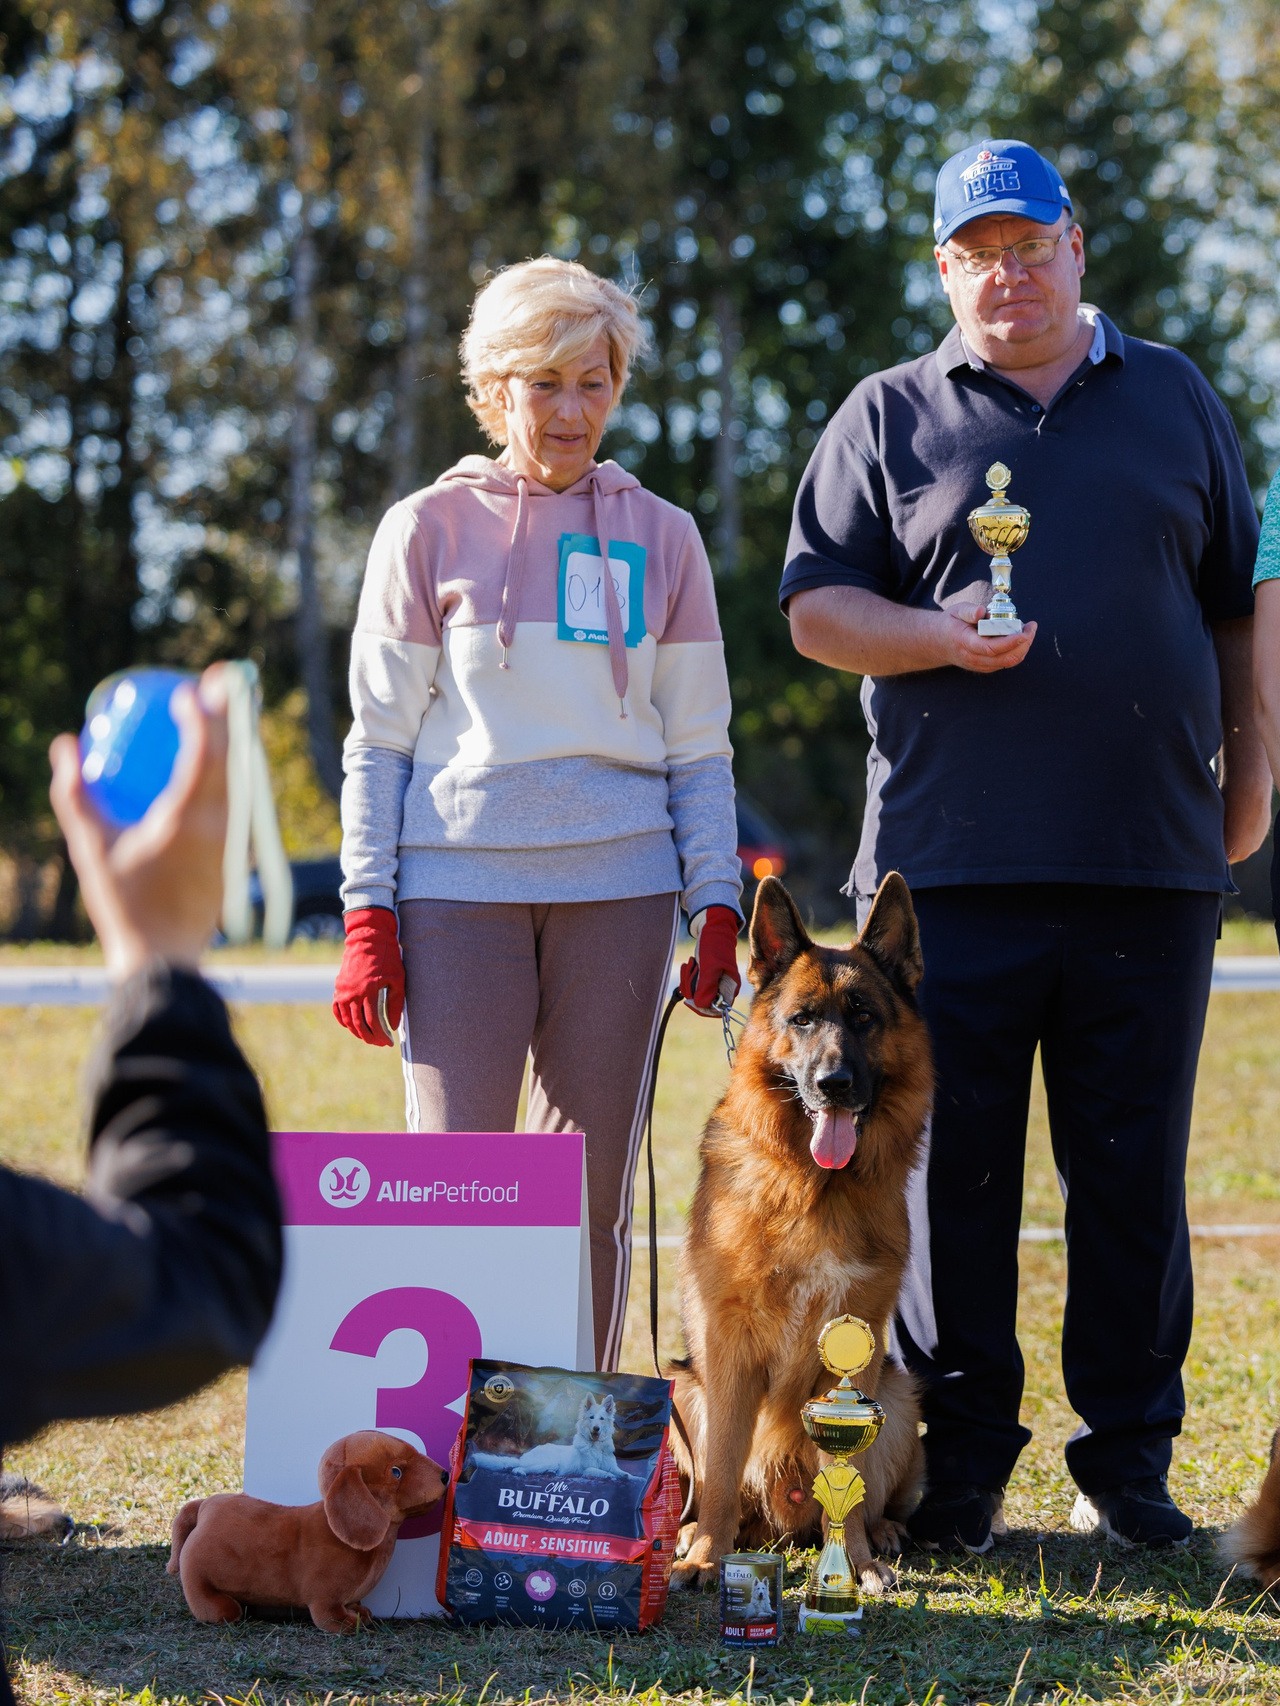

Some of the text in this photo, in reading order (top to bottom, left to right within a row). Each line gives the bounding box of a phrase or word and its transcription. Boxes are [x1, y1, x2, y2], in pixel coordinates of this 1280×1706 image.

[963, 171, 1021, 203] 1946
[376, 1181, 519, 1203] AllerPetfood
[329, 1286, 483, 1540] 3
[498, 1488, 610, 1517] BUFFALO
[512, 1511, 543, 1521] Premium
[483, 1530, 611, 1555] ADULT SENSITIVE
[533, 1604, 546, 1613] 2 kg
[725, 1626, 745, 1637] ADULT
